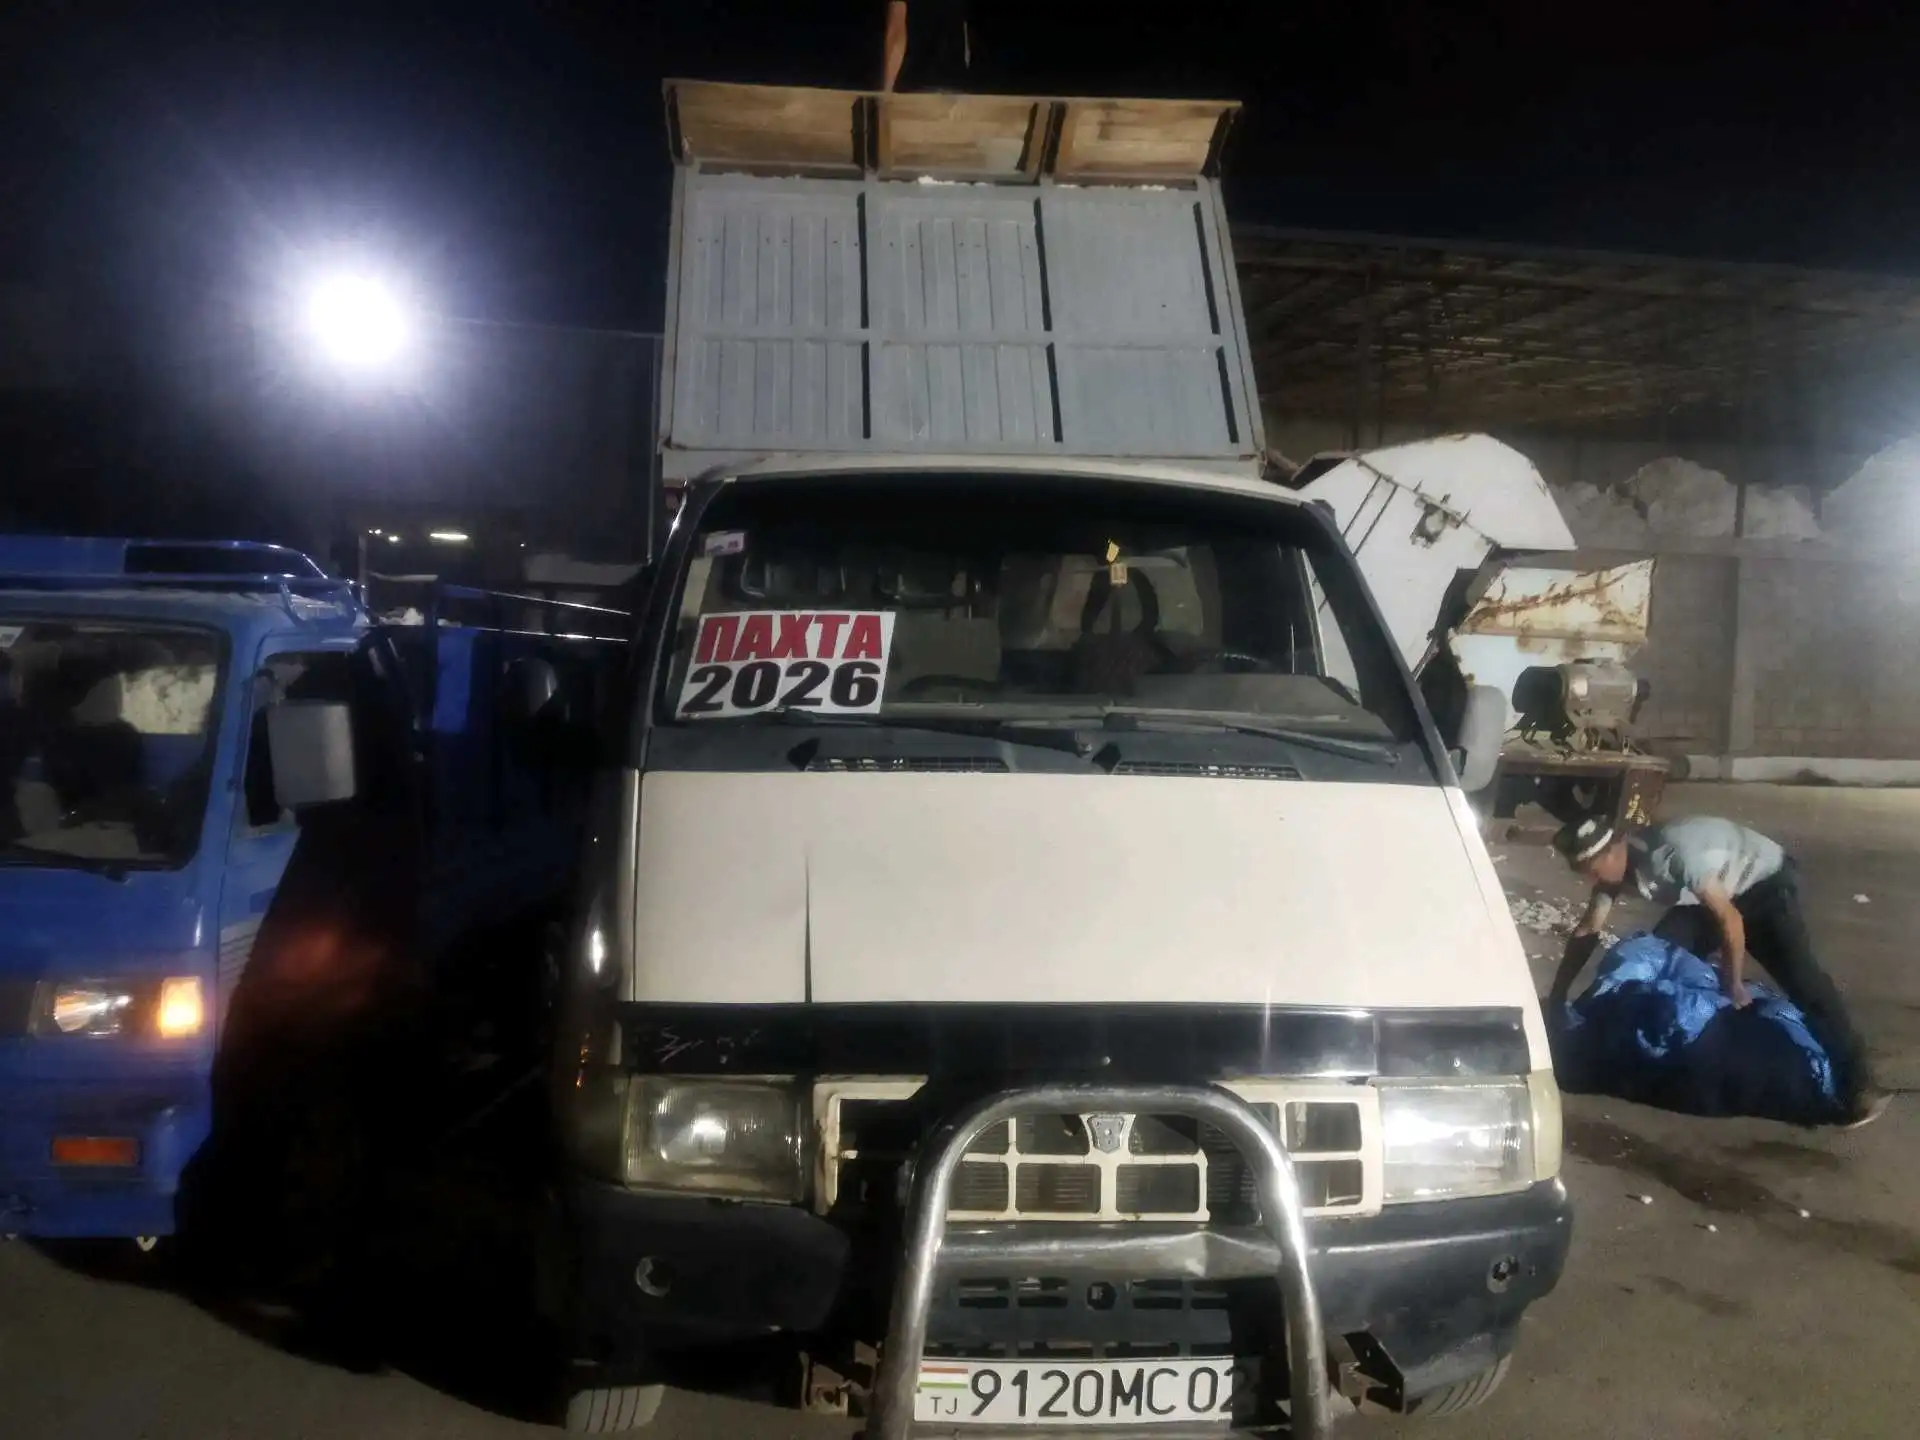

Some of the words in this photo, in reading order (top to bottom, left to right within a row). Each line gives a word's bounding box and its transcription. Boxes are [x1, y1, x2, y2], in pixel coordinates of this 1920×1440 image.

[694, 614, 883, 664] ПАХТА
[681, 660, 881, 713] 2026
[929, 1396, 959, 1416] TJ
